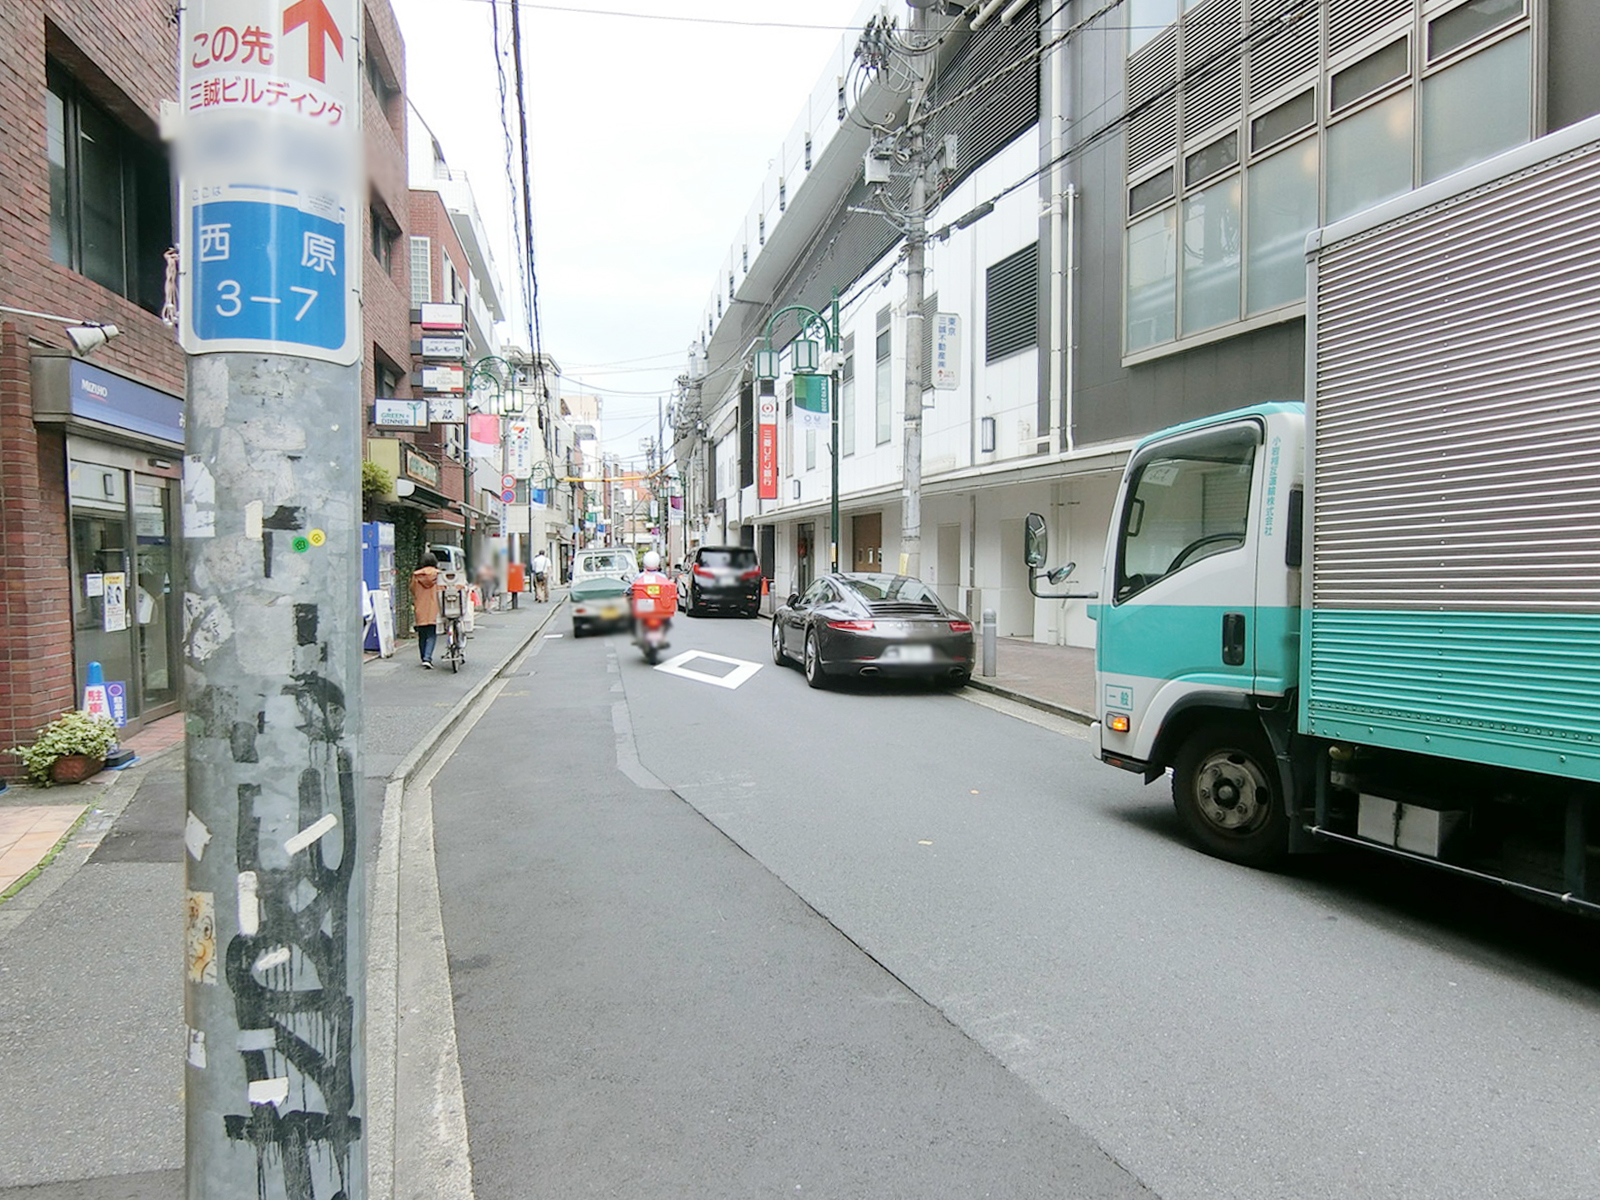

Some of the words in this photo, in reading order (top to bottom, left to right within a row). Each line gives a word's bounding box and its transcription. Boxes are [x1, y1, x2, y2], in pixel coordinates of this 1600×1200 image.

[192, 26, 275, 69] この先
[189, 76, 344, 125] 三誠ビルディング
[191, 185, 223, 202] ここは
[199, 222, 338, 277] 西原
[81, 378, 109, 398] MIZUHO
